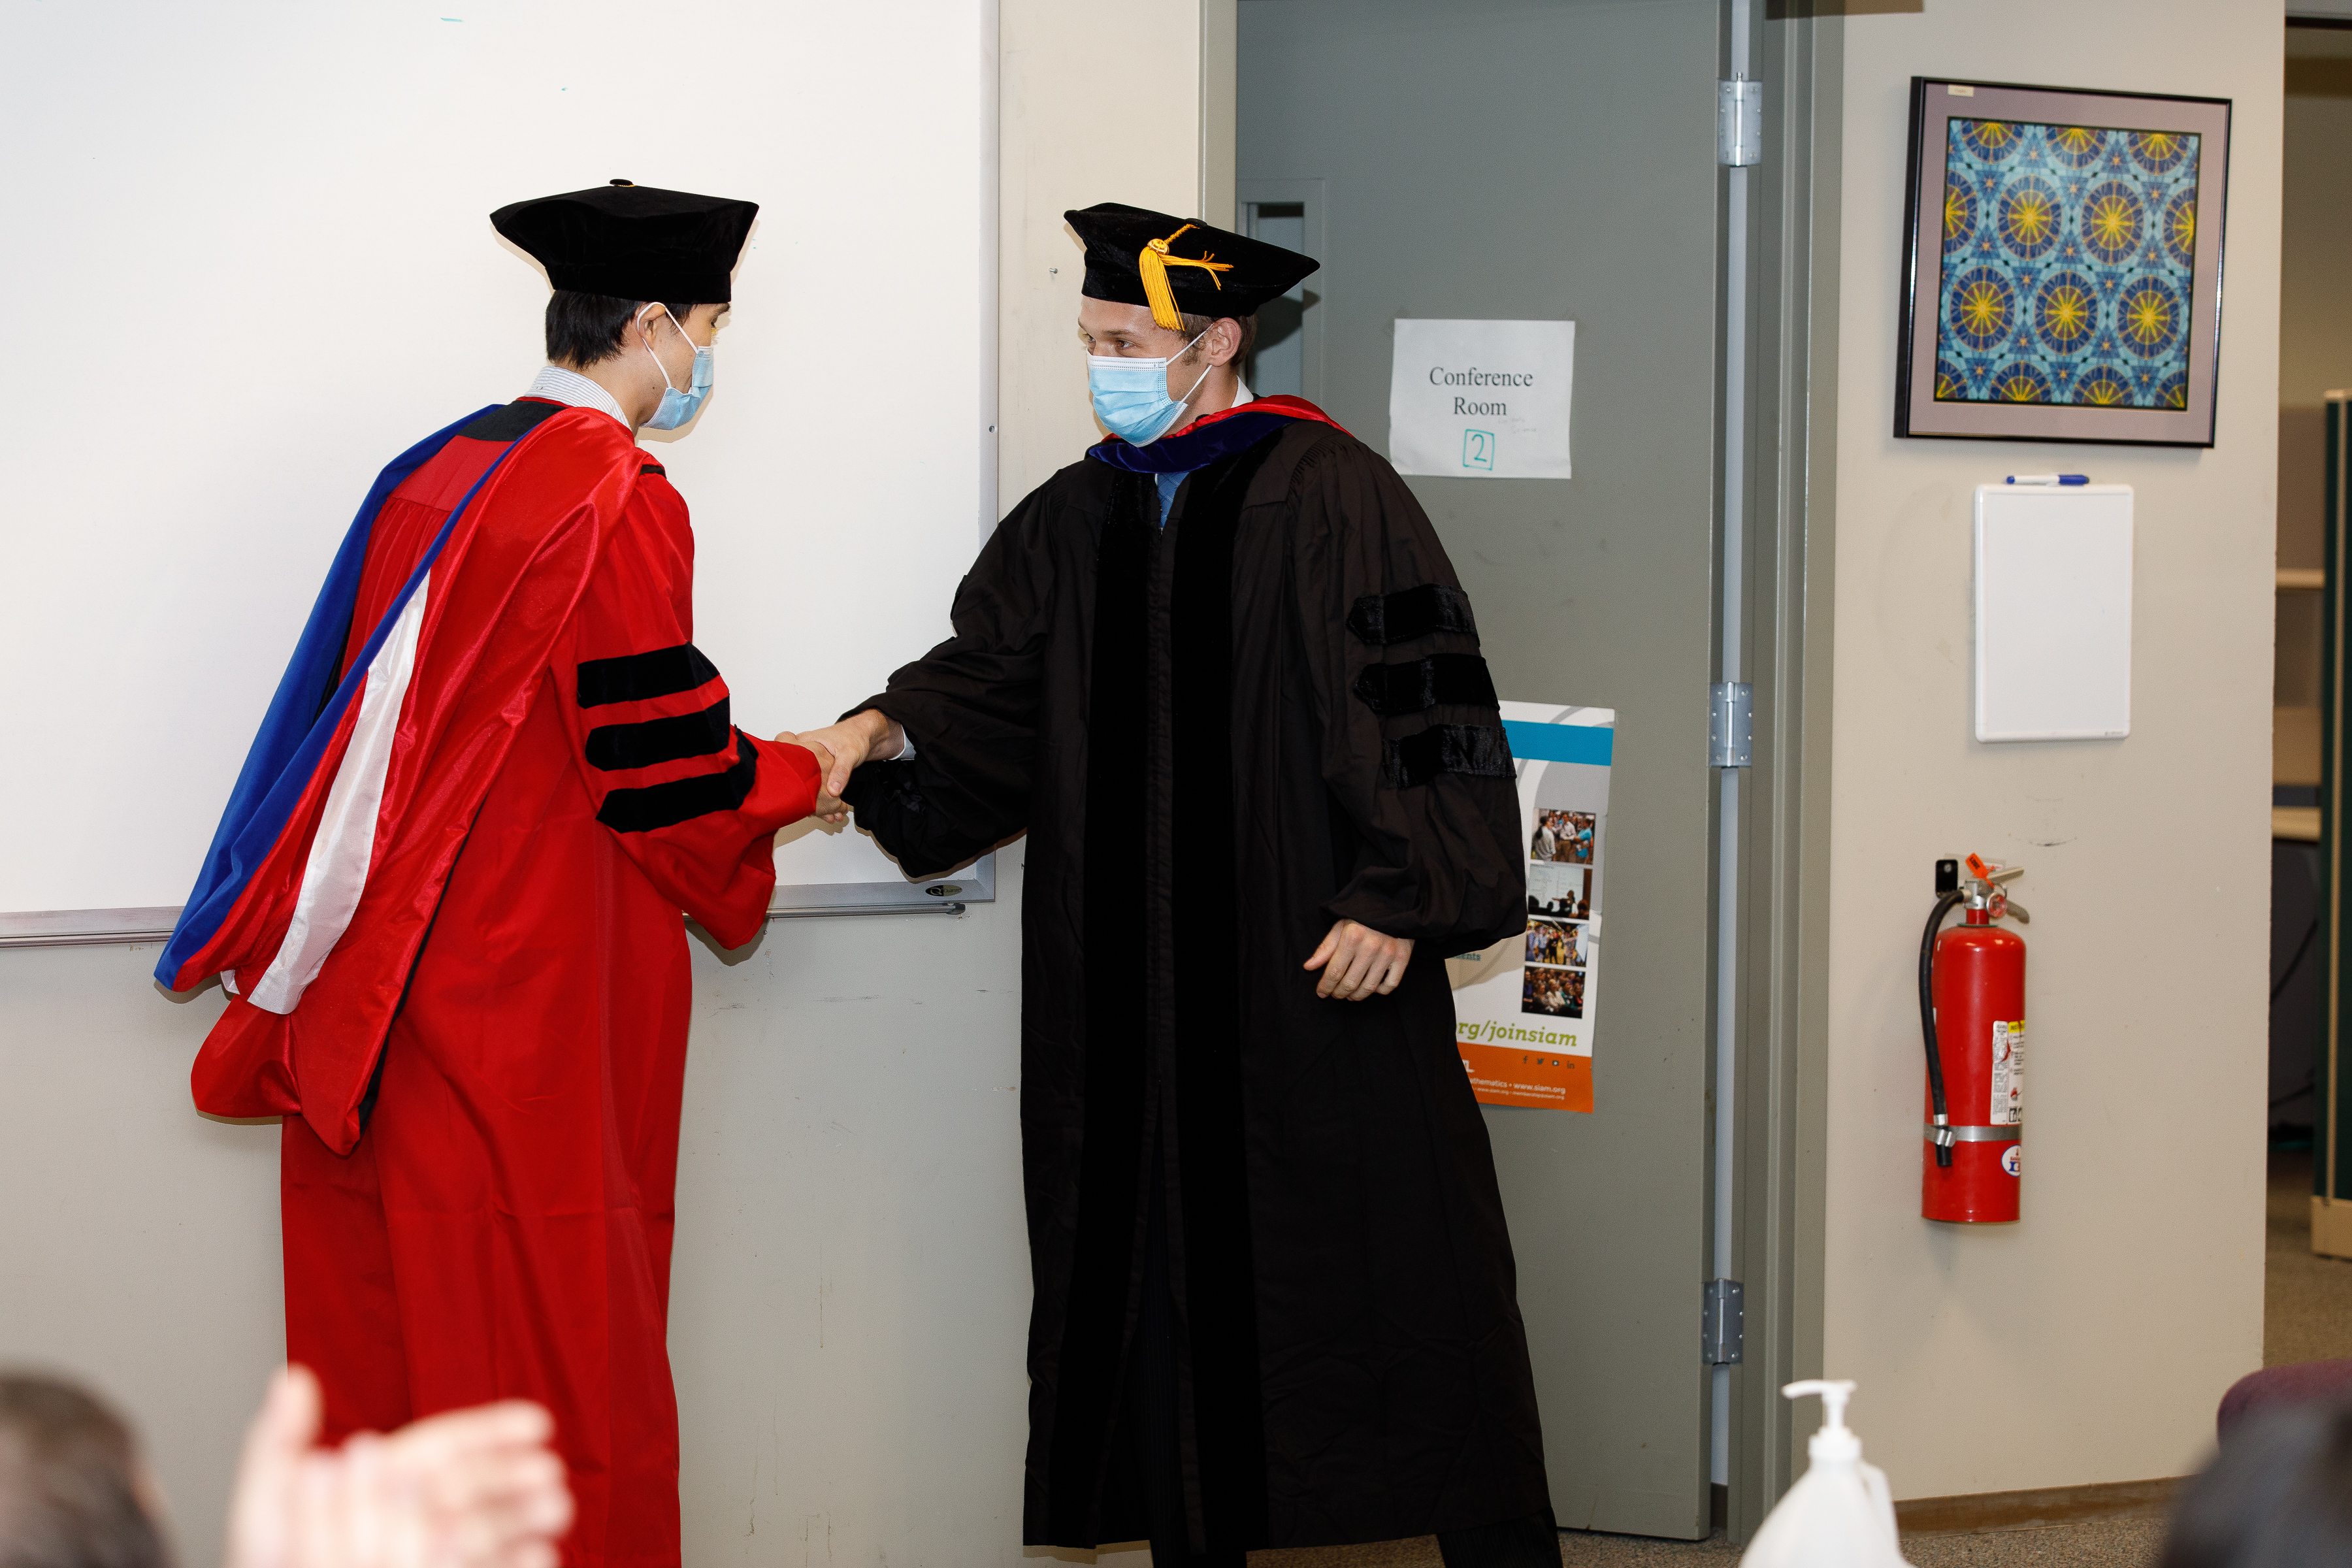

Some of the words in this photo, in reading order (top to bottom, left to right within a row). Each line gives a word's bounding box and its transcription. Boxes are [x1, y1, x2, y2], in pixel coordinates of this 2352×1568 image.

[1429, 366, 1533, 387] Conference
[1454, 396, 1507, 416] Room
[1471, 434, 1487, 463] 2
[1456, 1019, 1576, 1047] rg/joinsiam
[1513, 1083, 1566, 1095] www.siam.org
